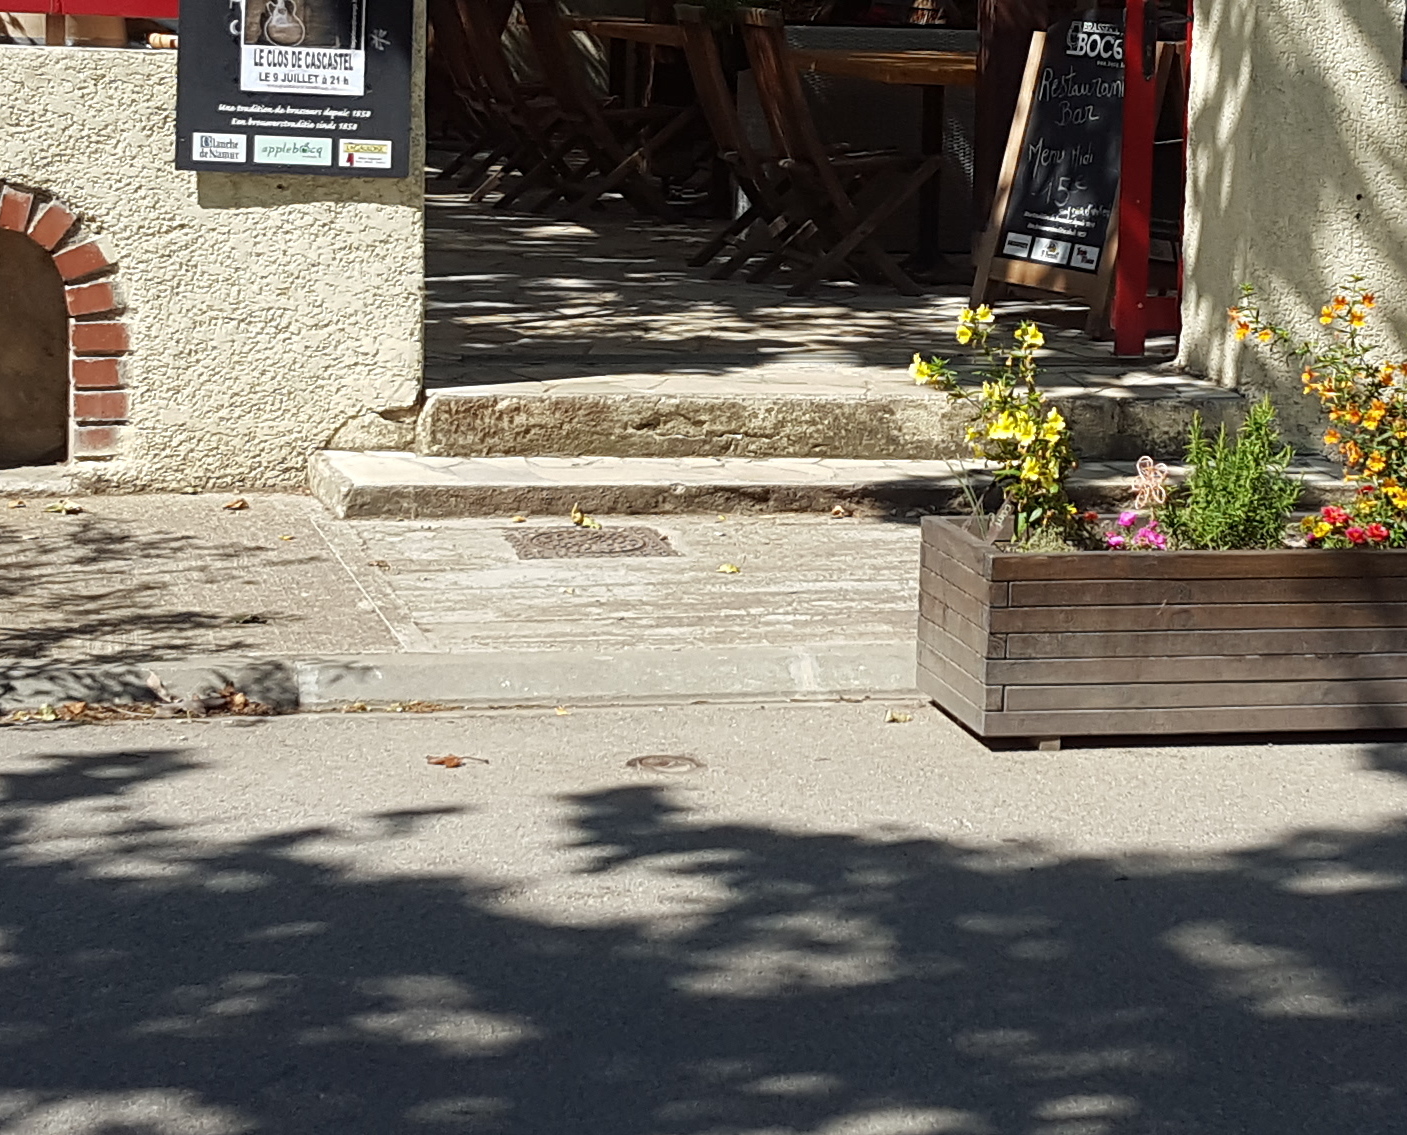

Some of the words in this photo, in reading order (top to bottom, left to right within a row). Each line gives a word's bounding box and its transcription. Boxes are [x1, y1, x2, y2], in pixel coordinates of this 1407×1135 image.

[254, 48, 264, 67] LE
[266, 50, 289, 68] CLOS
[291, 51, 303, 69] DE
[304, 52, 354, 72] CASCASTEL
[258, 71, 271, 83] LE
[273, 72, 279, 83] 9
[281, 72, 320, 85] JUILLET
[330, 75, 341, 86] 21
[343, 76, 350, 86] h
[1054, 100, 1100, 126] Bar
[199, 148, 208, 159] de
[209, 147, 240, 160] Namur
[1028, 137, 1065, 179] Menu
